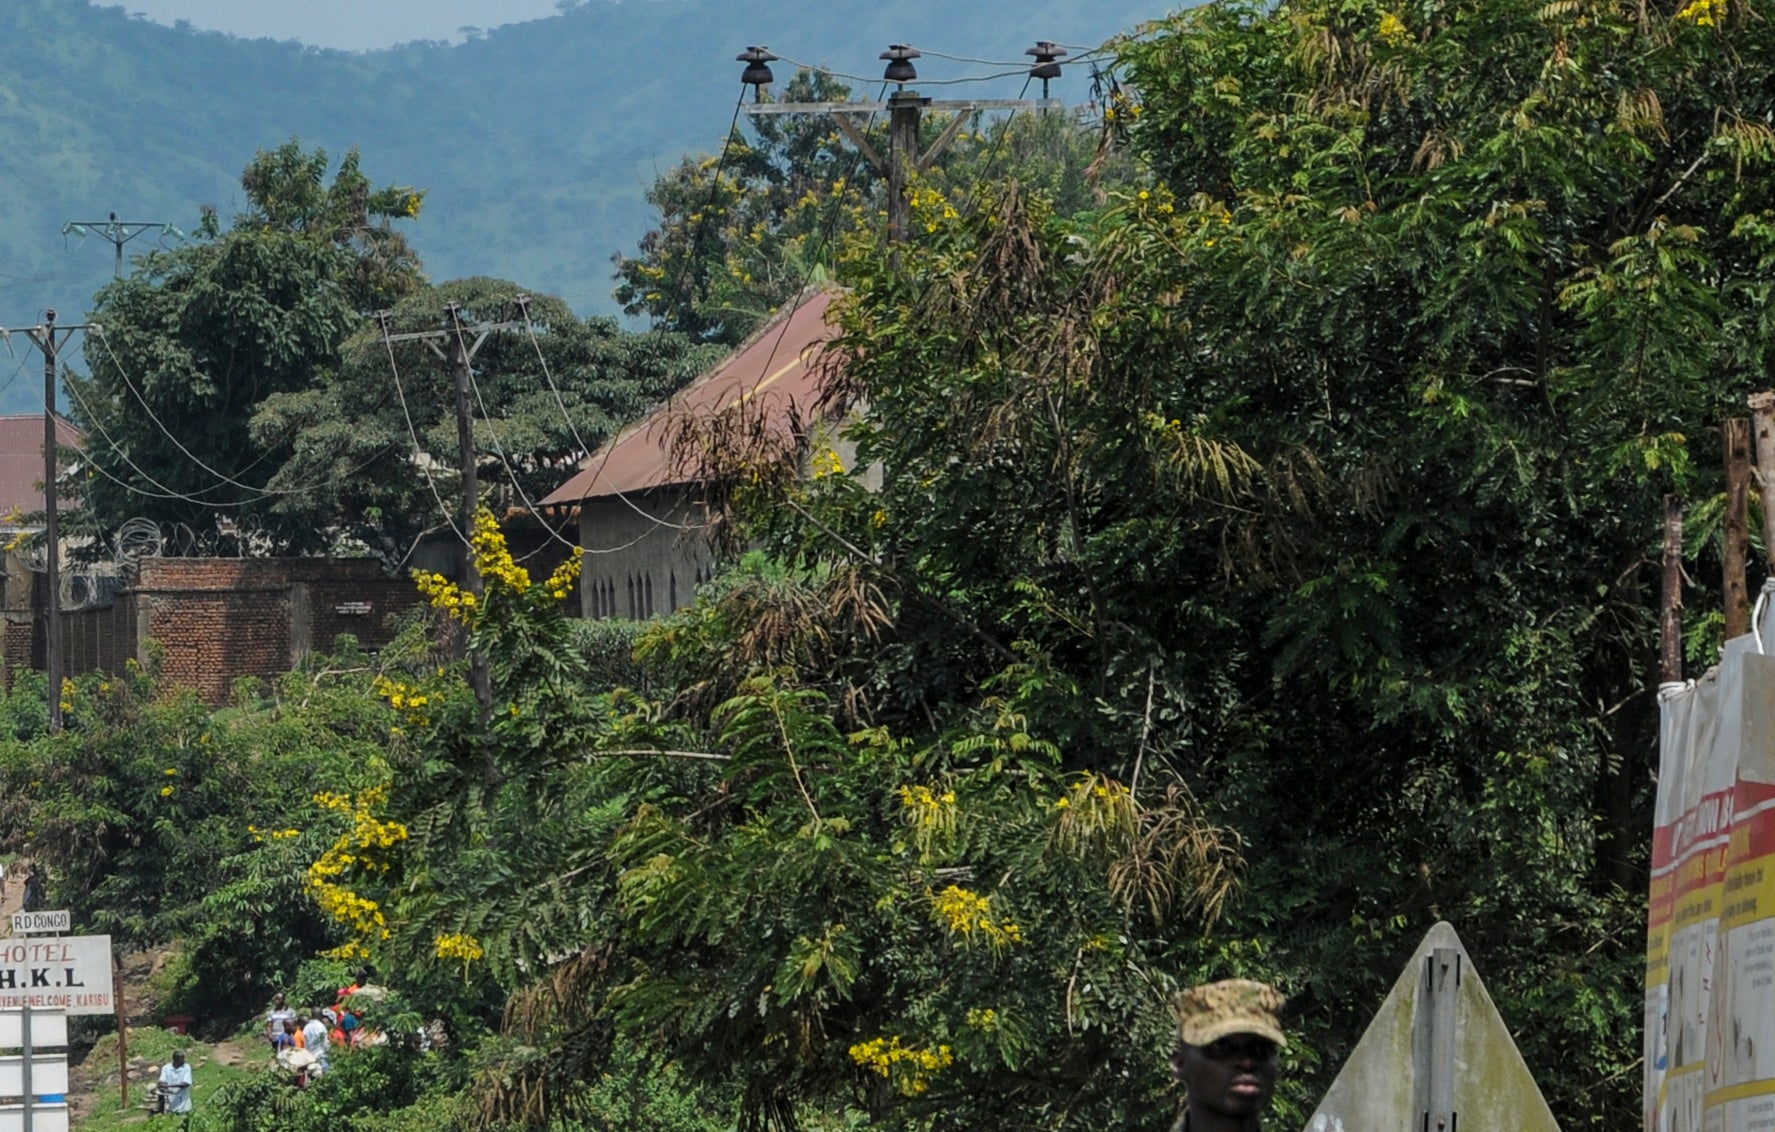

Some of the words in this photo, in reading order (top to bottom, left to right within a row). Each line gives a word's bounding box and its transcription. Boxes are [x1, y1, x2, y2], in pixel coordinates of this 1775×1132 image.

[33, 913, 67, 928] CONGO
[28, 994, 72, 1007] WELCOME
[76, 993, 109, 1006] KARIBU
